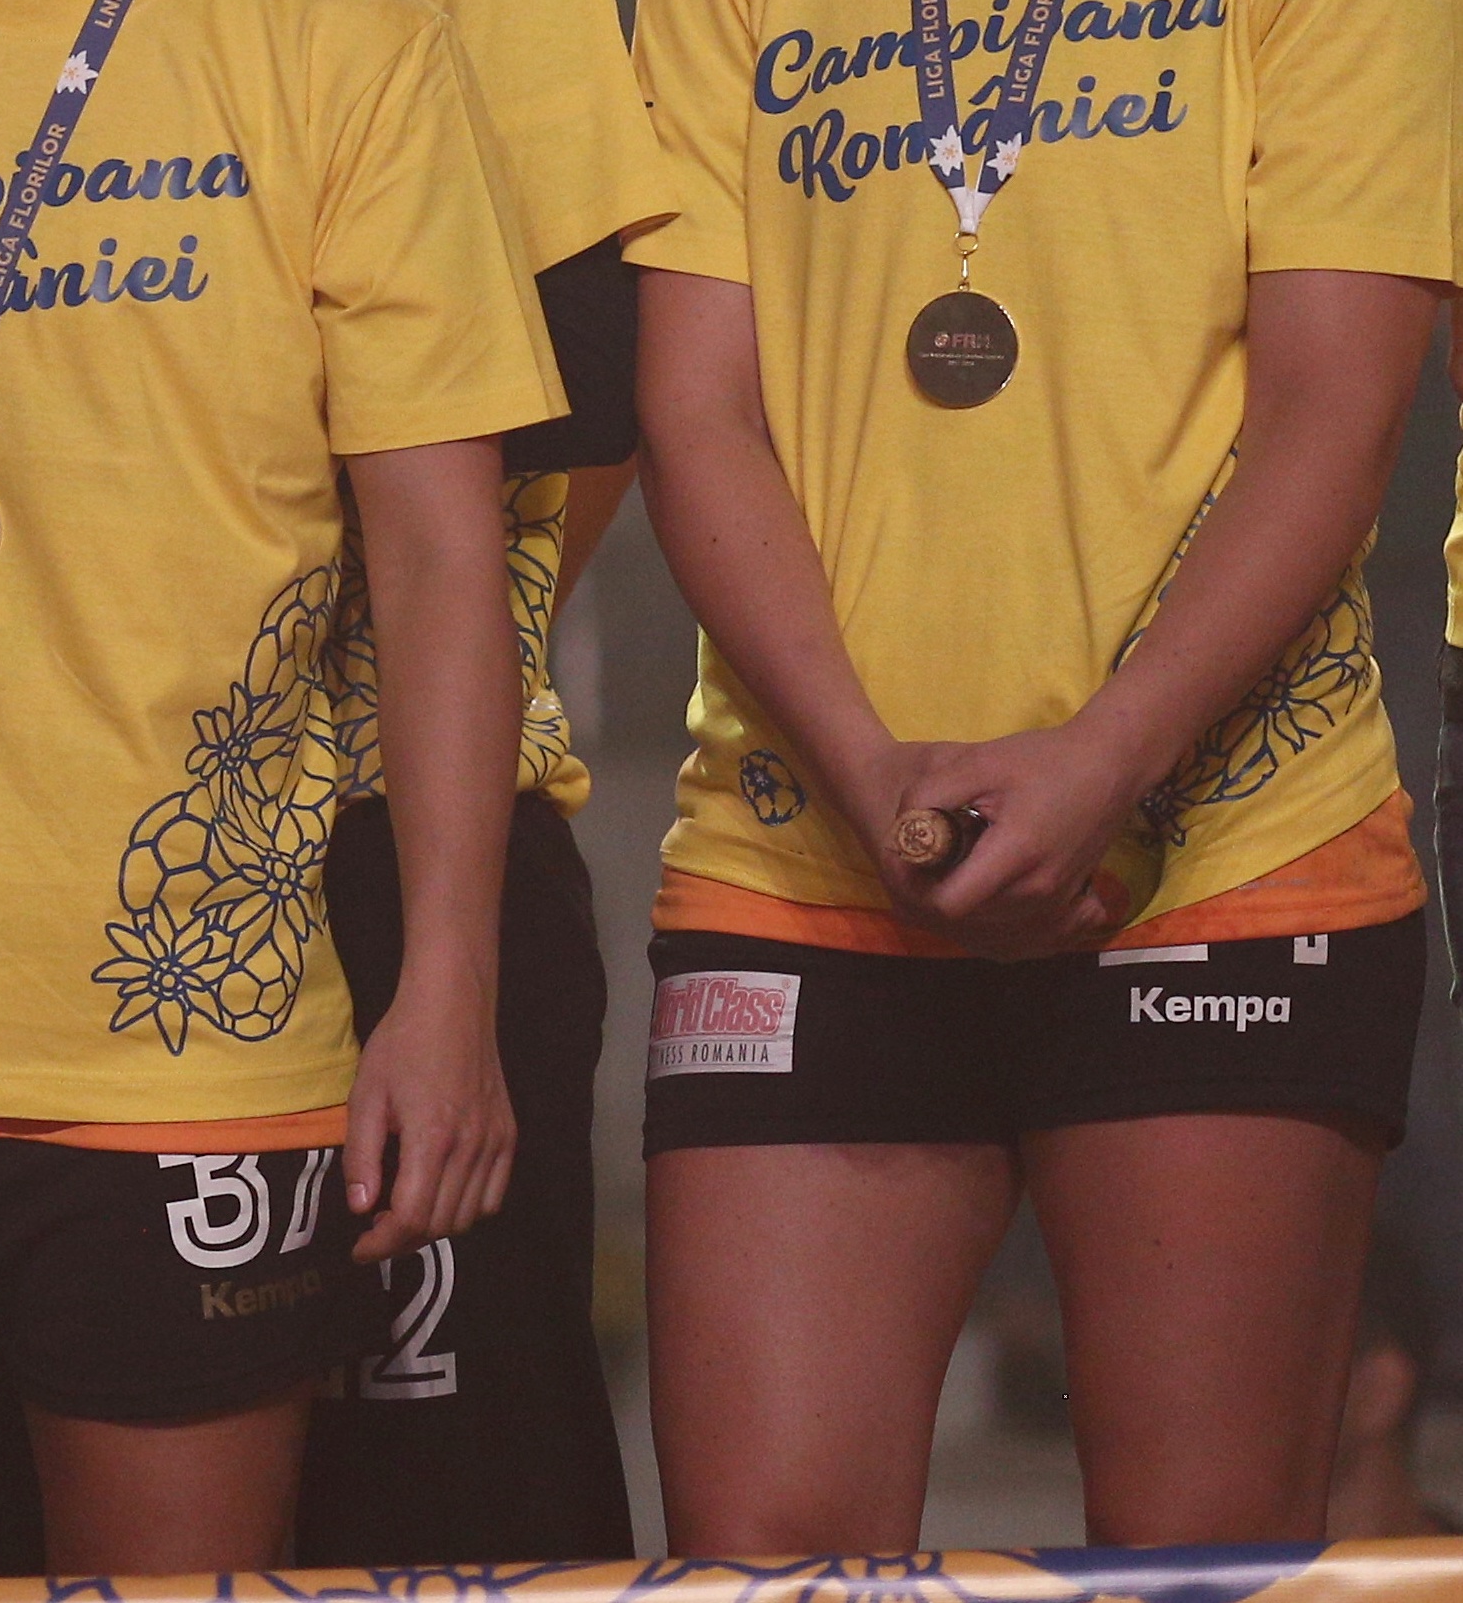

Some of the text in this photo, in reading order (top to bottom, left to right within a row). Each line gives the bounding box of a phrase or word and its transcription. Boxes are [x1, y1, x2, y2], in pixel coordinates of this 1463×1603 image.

[925, 48, 945, 99] LIGA
[1008, 53, 1037, 103] LIGA
[9, 123, 67, 230] FLORILOR
[702, 977, 787, 1036] Class
[1130, 987, 1291, 1033] Kempa
[691, 1043, 769, 1063] ROMANIA
[199, 1270, 322, 1321] Kempa
